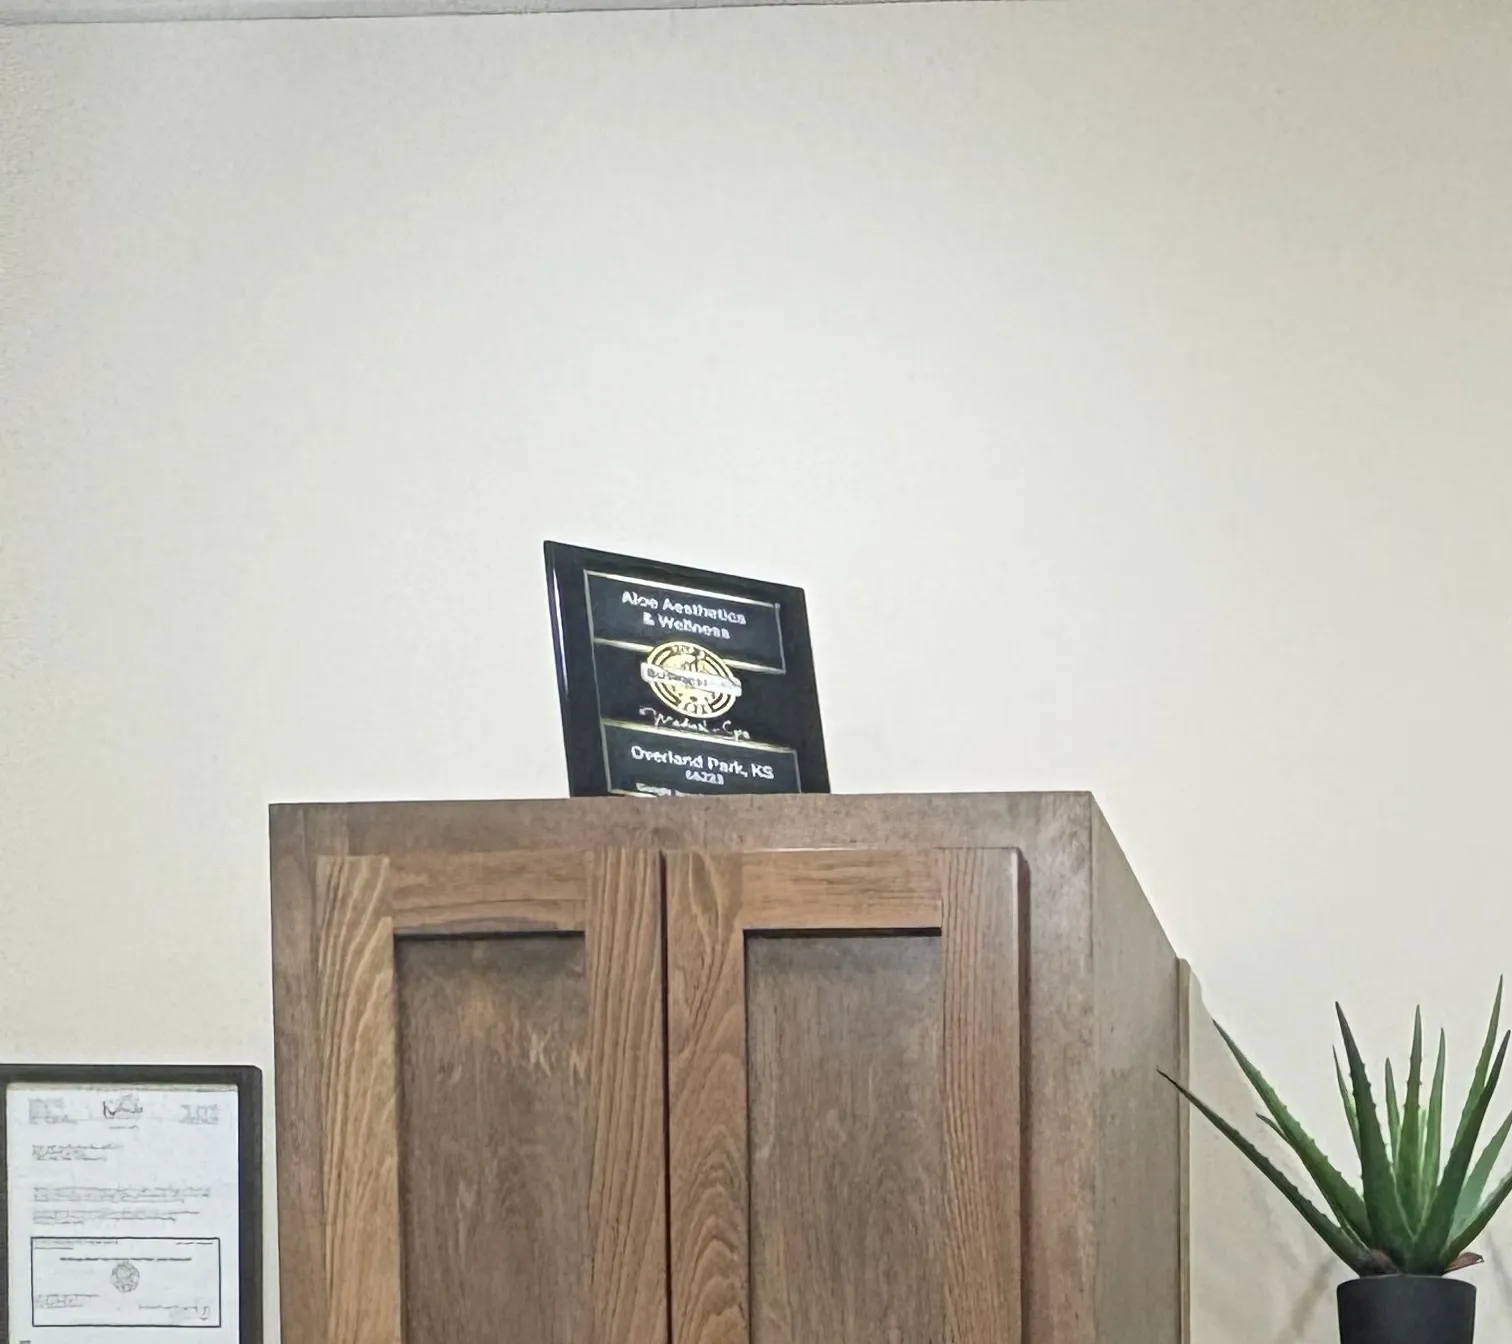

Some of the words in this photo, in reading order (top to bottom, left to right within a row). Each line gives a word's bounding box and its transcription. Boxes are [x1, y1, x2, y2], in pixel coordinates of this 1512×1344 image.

[621, 590, 659, 609] Aloe
[662, 597, 747, 625] Aesthetics
[658, 612, 731, 639] Wellness
[630, 745, 704, 769] Overland
[706, 756, 748, 778] Park,
[751, 762, 775, 780] KS
